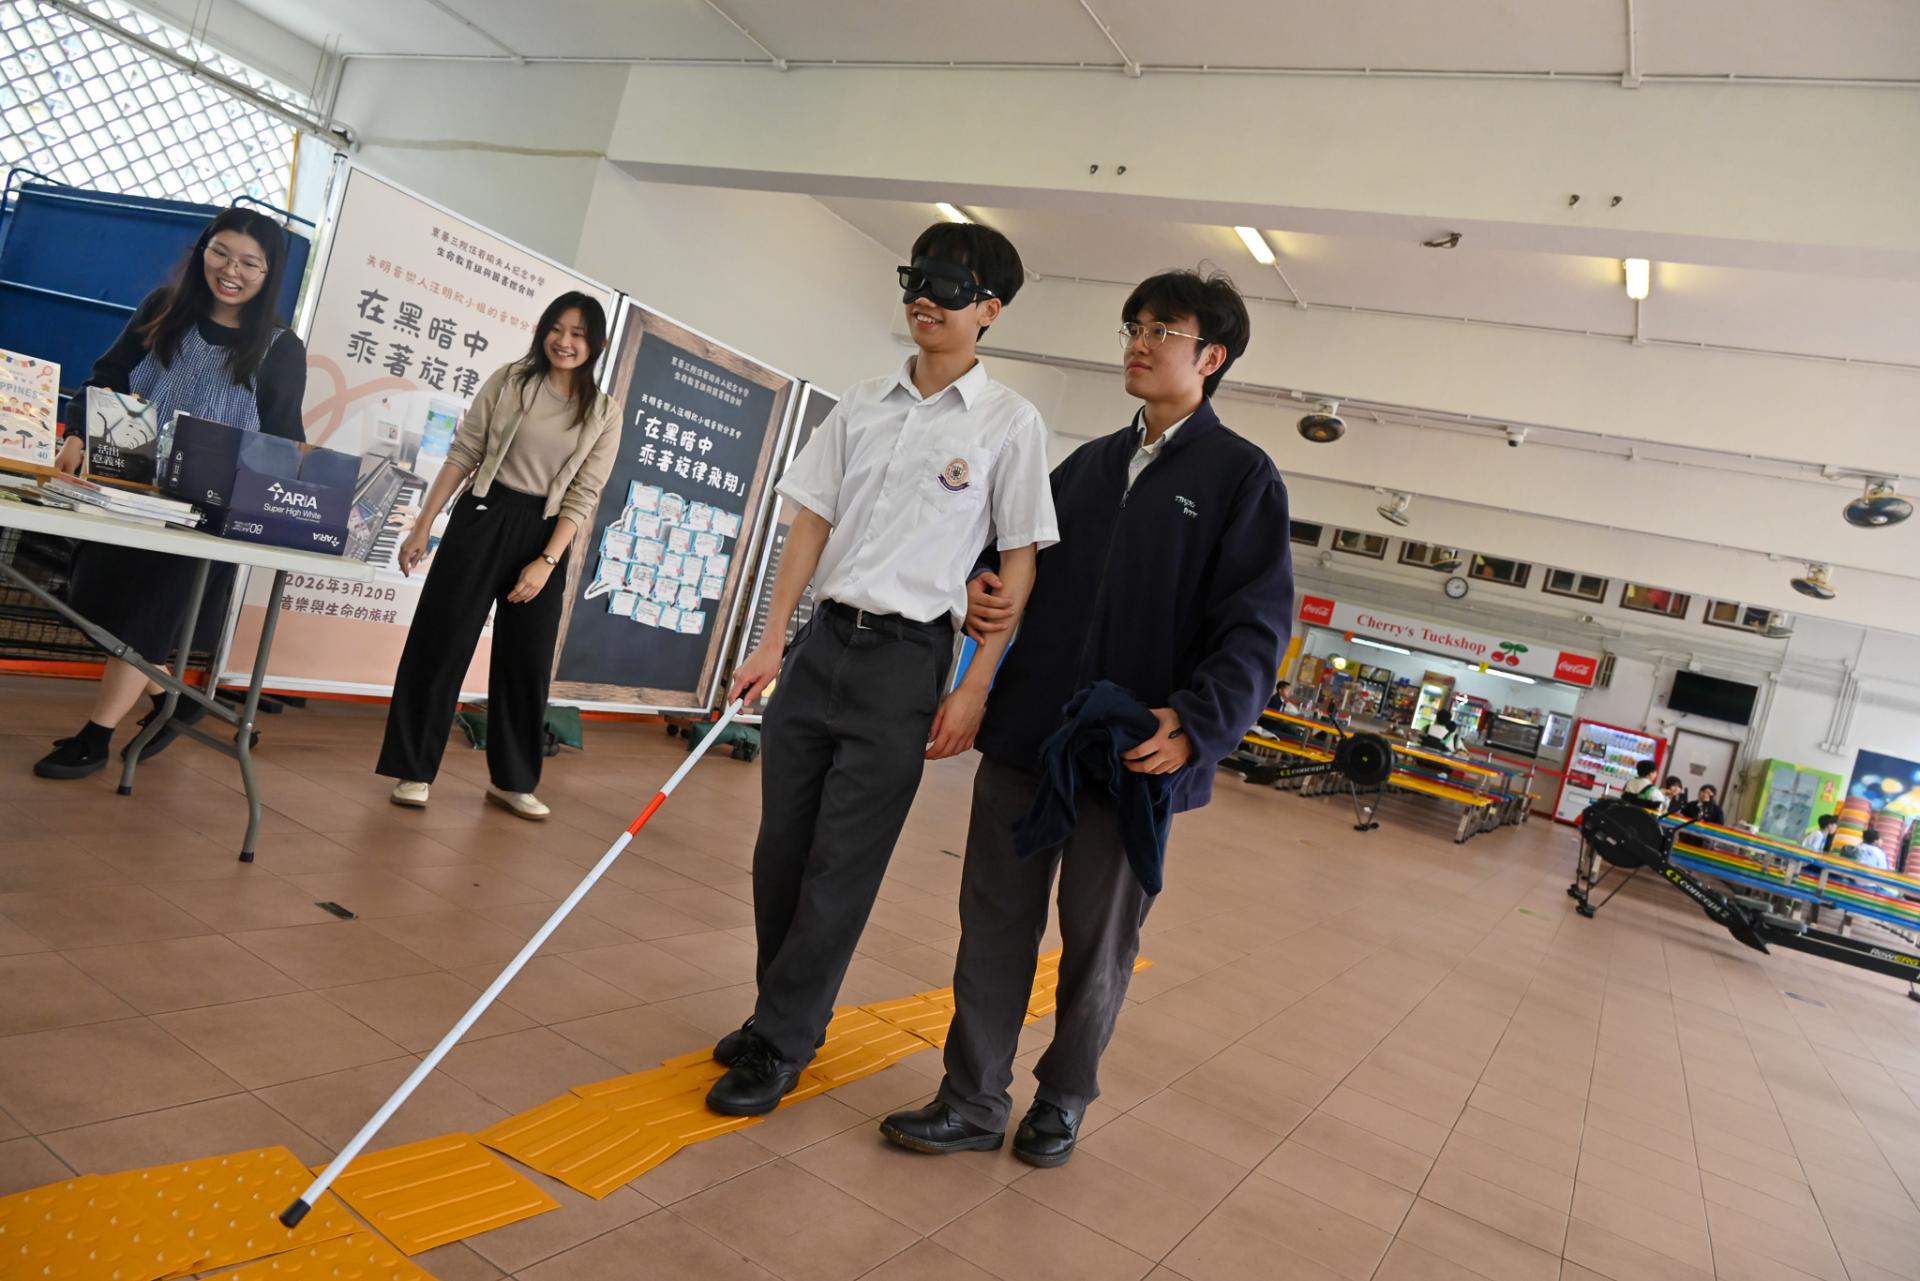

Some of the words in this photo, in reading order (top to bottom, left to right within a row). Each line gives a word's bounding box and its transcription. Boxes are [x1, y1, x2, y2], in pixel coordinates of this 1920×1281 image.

[357, 289, 489, 359] 在黑暗中
[346, 329, 481, 400] 乘著旋律
[634, 409, 714, 456] 「在黑暗中
[638, 443, 747, 498] 乘著旋律飛翔」
[248, 522, 264, 536] 80
[263, 502, 285, 517] Super
[285, 506, 303, 520] High
[302, 508, 322, 520] White
[281, 595, 397, 623] 音樂與生命的旅程
[285, 574, 396, 602] 2026年3月20日
[1357, 612, 1415, 638] Cherry's
[1421, 628, 1487, 656] Tuckshop
